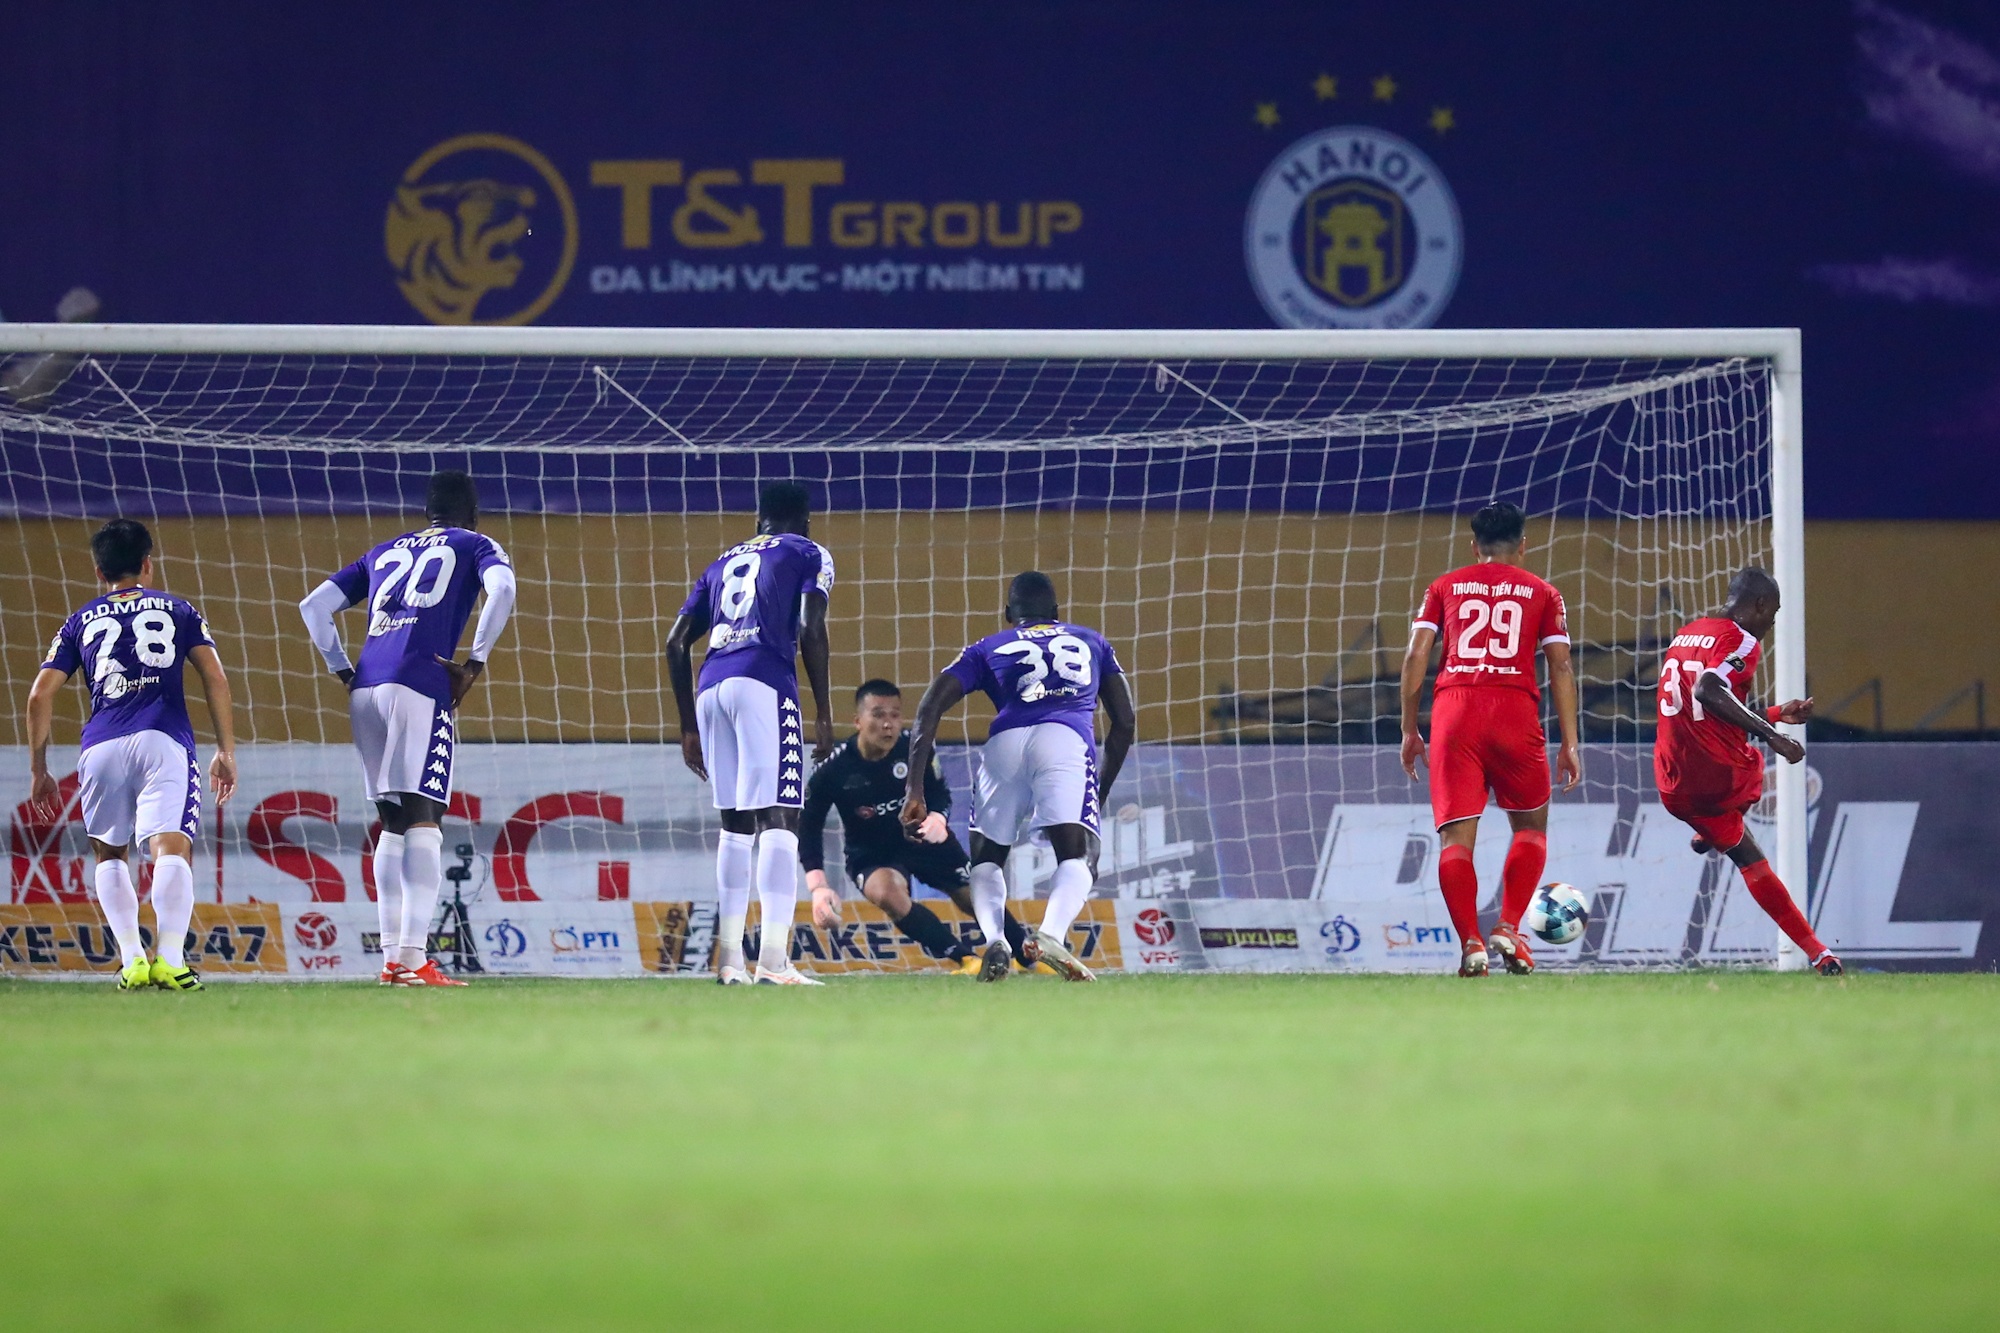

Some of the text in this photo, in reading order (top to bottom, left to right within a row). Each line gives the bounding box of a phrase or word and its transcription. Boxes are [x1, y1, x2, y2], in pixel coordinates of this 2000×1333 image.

[1281, 141, 1428, 195] HANOI
[591, 160, 1082, 248] T&T GROUP
[1022, 264, 1083, 291] TIN
[393, 535, 448, 549] OMAR
[371, 545, 457, 614] 20
[720, 552, 761, 621] 8
[1512, 584, 1534, 599] ANH
[81, 597, 173, 625] D.D.MANH
[1458, 599, 1523, 658] 29
[1669, 634, 1716, 649] RUNO
[82, 610, 176, 682] 28
[993, 634, 1092, 692] 38
[1660, 658, 1705, 721] 37
[583, 932, 619, 948] PTI
[1415, 927, 1451, 943] PTI
[299, 955, 342, 969] VPF
[1139, 951, 1179, 964] VPF
